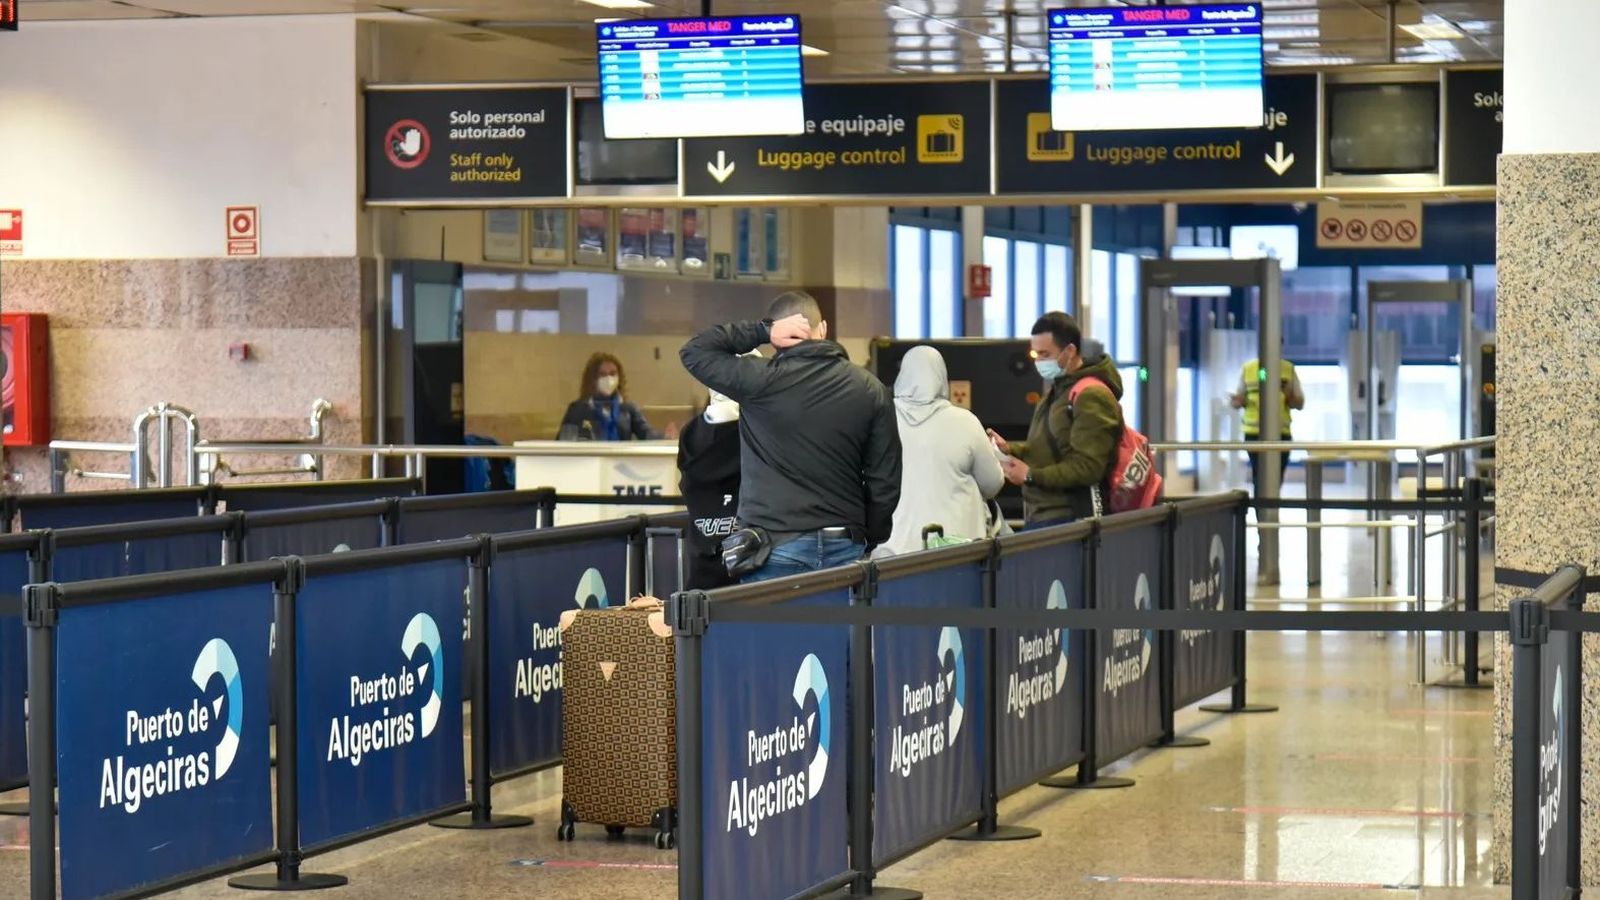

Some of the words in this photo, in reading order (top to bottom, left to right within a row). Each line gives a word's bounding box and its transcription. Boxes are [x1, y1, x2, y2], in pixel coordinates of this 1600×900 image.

[667, 22, 707, 33] TANGER
[708, 20, 732, 32] MED
[1122, 10, 1164, 21] TANGER
[1165, 9, 1190, 20] MED
[449, 110, 481, 124] Solo
[484, 109, 545, 126] personal
[449, 125, 526, 139] autorizado
[821, 114, 905, 136] equipaje
[450, 153, 482, 167] Staff
[485, 153, 513, 168] only
[757, 149, 835, 170] Luggage
[841, 147, 906, 165] control
[1086, 144, 1168, 165] Luggage
[1173, 140, 1241, 159] control
[450, 168, 521, 182] authorized
[533, 622, 563, 650] Puert
[1019, 633, 1043, 665] Puerto
[1045, 627, 1053, 656] de
[350, 672, 396, 707] Puerto
[399, 666, 414, 697] de
[515, 651, 563, 704] Algeci
[1007, 665, 1053, 719] Algeciras
[1103, 650, 1140, 698] Algeciras
[903, 681, 932, 716] Puerto
[935, 672, 945, 704] de
[126, 707, 184, 747] Puerto
[188, 698, 209, 734] de
[327, 707, 415, 766] Algeciras
[748, 726, 786, 767] Puerto
[789, 716, 805, 752] de
[890, 716, 945, 777] Algeciras
[100, 746, 210, 814] Algeciras
[727, 766, 805, 837] Algeciras
